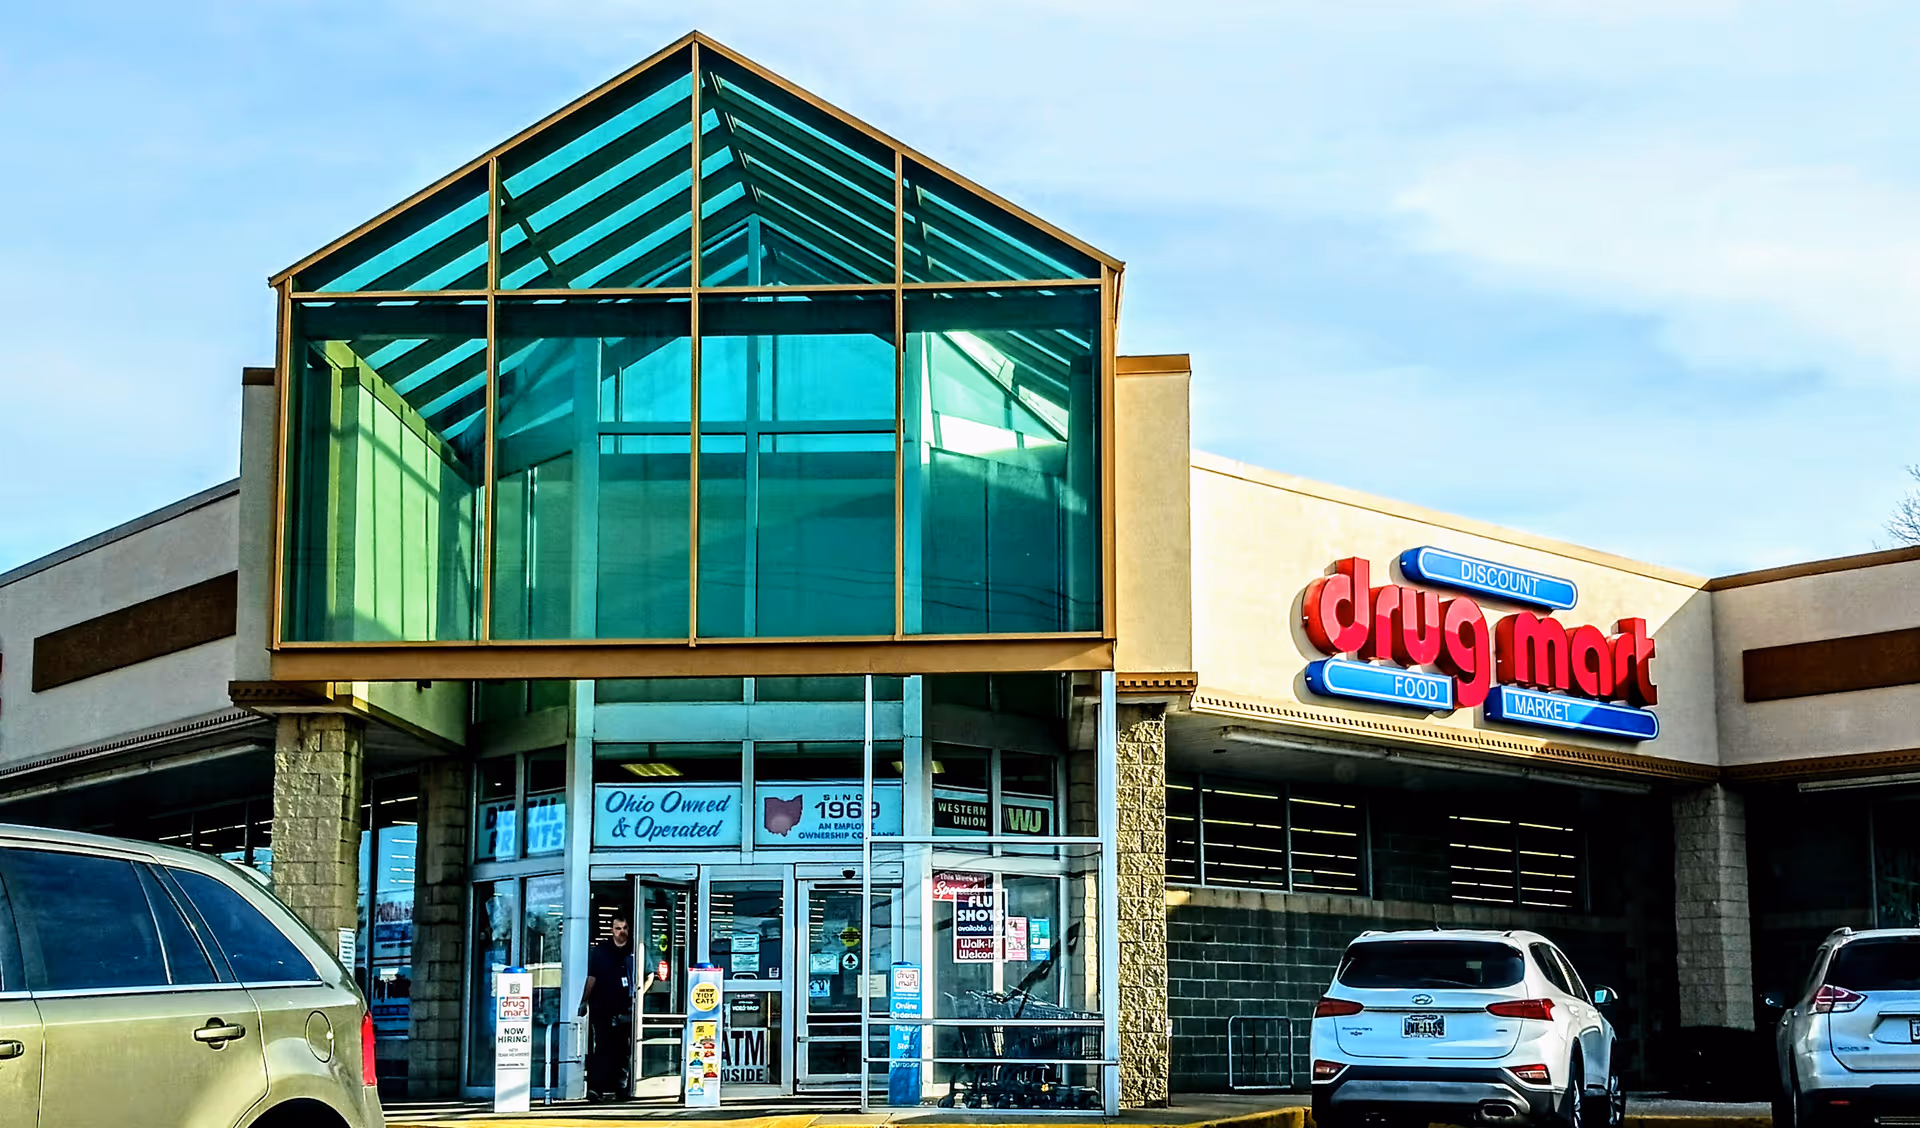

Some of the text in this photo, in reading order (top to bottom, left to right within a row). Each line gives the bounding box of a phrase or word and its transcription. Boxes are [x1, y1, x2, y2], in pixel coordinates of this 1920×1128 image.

[1461, 561, 1539, 597] DISCOUNT
[1304, 557, 1657, 707] drug mart
[1394, 675, 1438, 700] FOOD
[1515, 695, 1570, 721] MARKET
[605, 790, 732, 813] Ohio Owned
[485, 797, 558, 830] DIGTAL
[814, 801, 881, 819] 1969
[938, 802, 986, 816] WESTERN
[818, 822, 876, 830] AN EMPLOE
[953, 815, 986, 827] UNION
[1007, 807, 1042, 833] WU
[612, 815, 723, 842] & Operated
[487, 822, 563, 855] PRNTS
[968, 895, 994, 908] FLU
[957, 909, 1004, 922] SHOT
[957, 924, 987, 932] available
[960, 939, 994, 949] Walk-In
[959, 949, 994, 959] Welcom
[897, 971, 915, 980] drug
[502, 996, 525, 1010] drug
[895, 1002, 917, 1010] Online
[504, 1008, 529, 1017] mart
[498, 1035, 530, 1043] HIRING!
[722, 1030, 764, 1066] ATM
[722, 1068, 764, 1082] NSIDE
